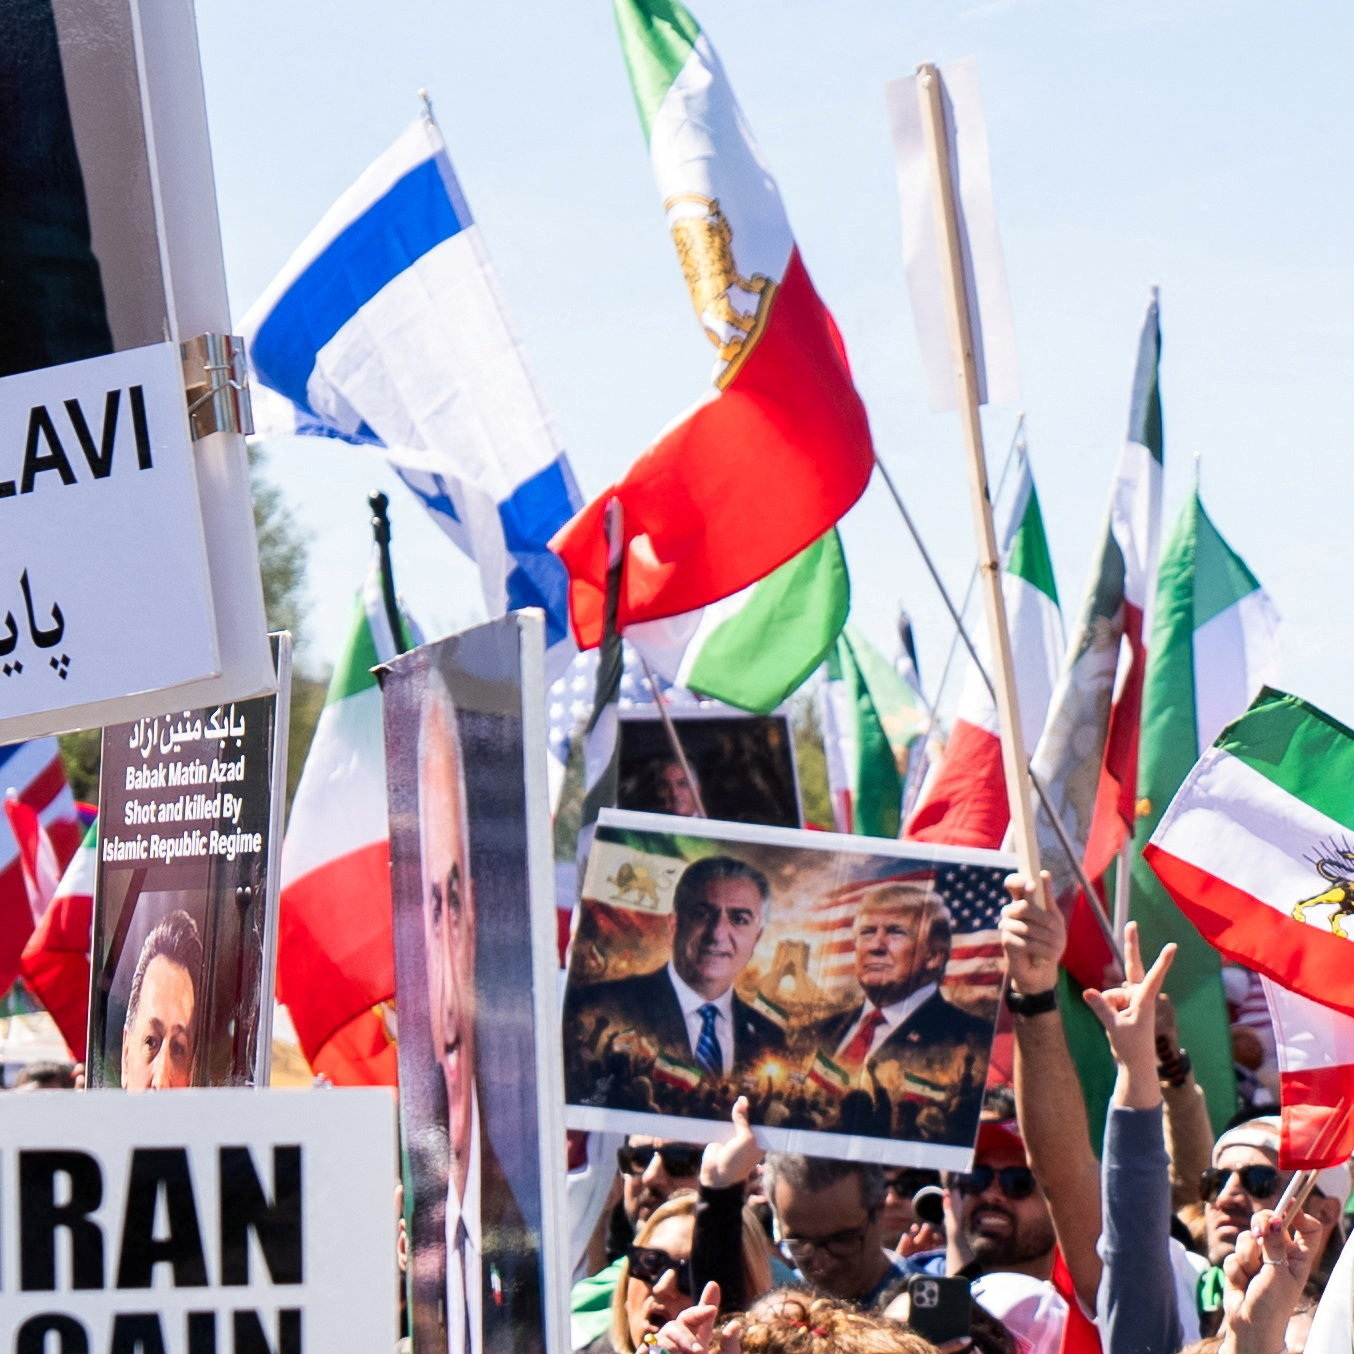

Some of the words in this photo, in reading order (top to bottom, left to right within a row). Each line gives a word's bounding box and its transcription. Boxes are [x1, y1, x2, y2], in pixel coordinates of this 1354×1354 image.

[125, 762, 166, 790] Babak
[168, 759, 208, 786] Matin
[209, 755, 245, 783] Azad
[124, 799, 157, 825] Shot
[158, 796, 184, 822] and
[184, 793, 221, 820] killed
[223, 793, 243, 824] By
[103, 834, 148, 862] Islamic
[150, 829, 208, 864] Republic
[209, 827, 262, 861] Regime
[0, 1143, 303, 1291] RAN
